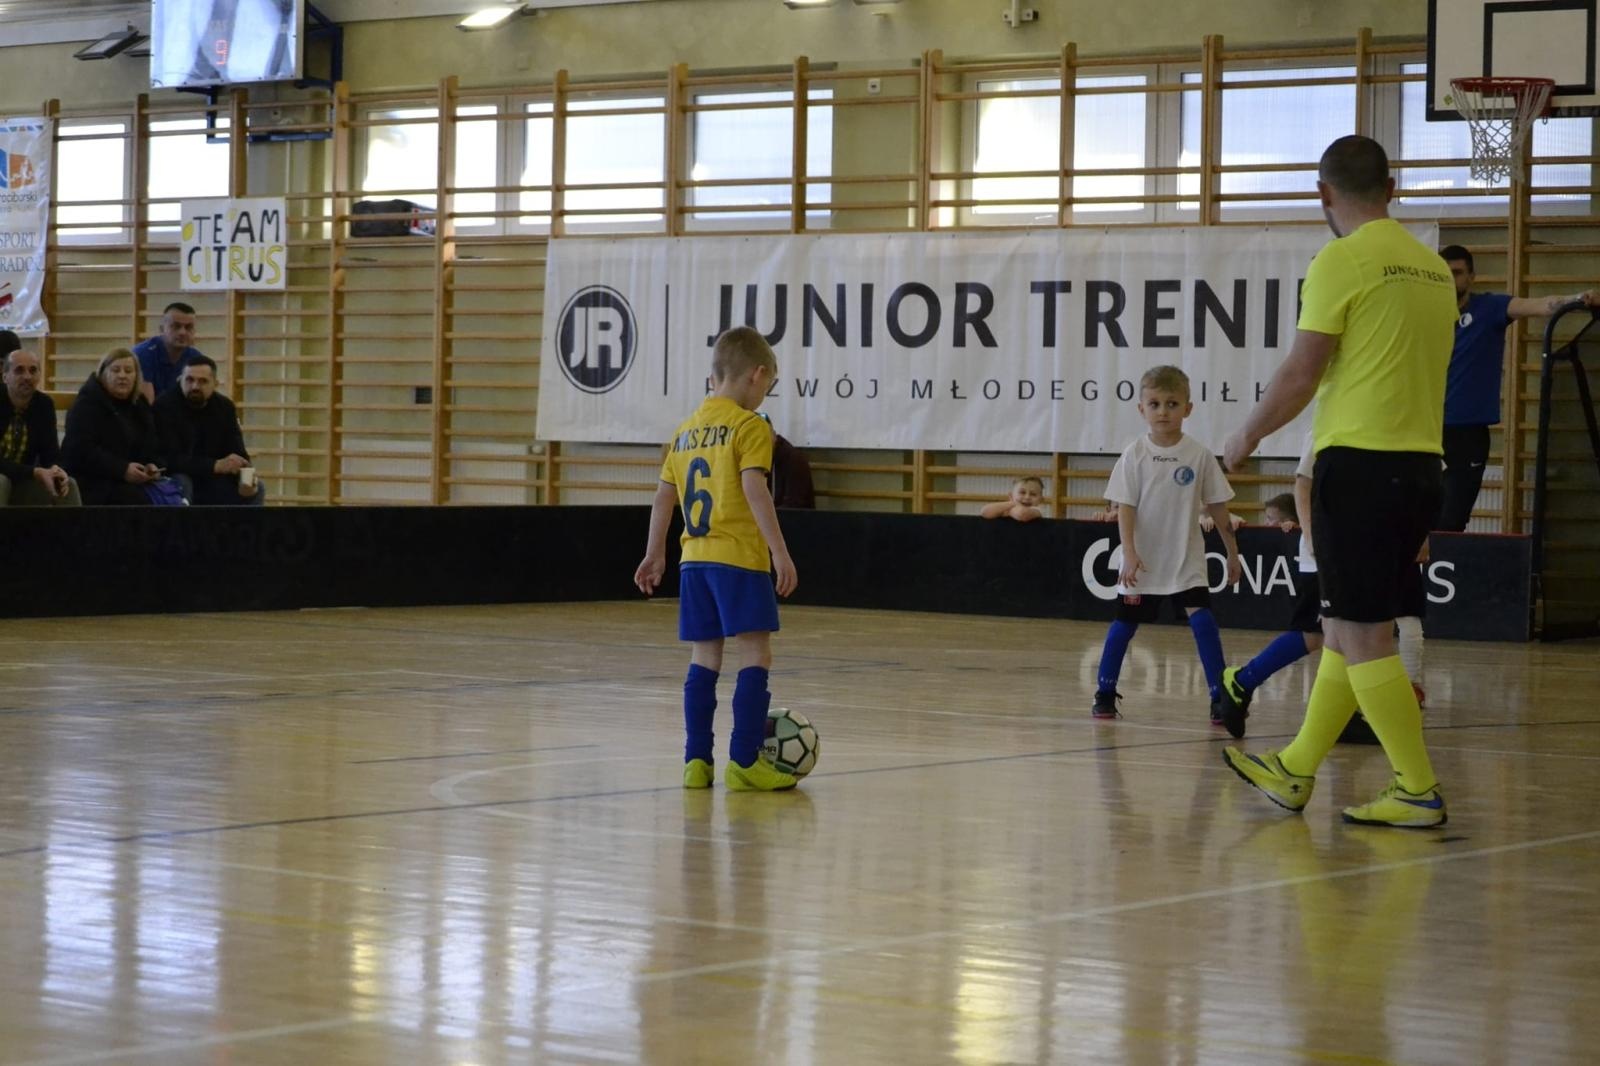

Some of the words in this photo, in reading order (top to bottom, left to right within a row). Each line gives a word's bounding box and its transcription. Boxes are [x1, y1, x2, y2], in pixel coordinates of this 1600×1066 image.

[193, 209, 280, 244] TEAM
[187, 245, 284, 284] CITRUS
[570, 307, 624, 369] JR
[706, 281, 998, 349] JUNIOR
[1030, 278, 1305, 348] TRENI
[704, 372, 879, 399] ZWÓJ
[910, 379, 1135, 401] MŁODEGO
[684, 457, 713, 536] 6
